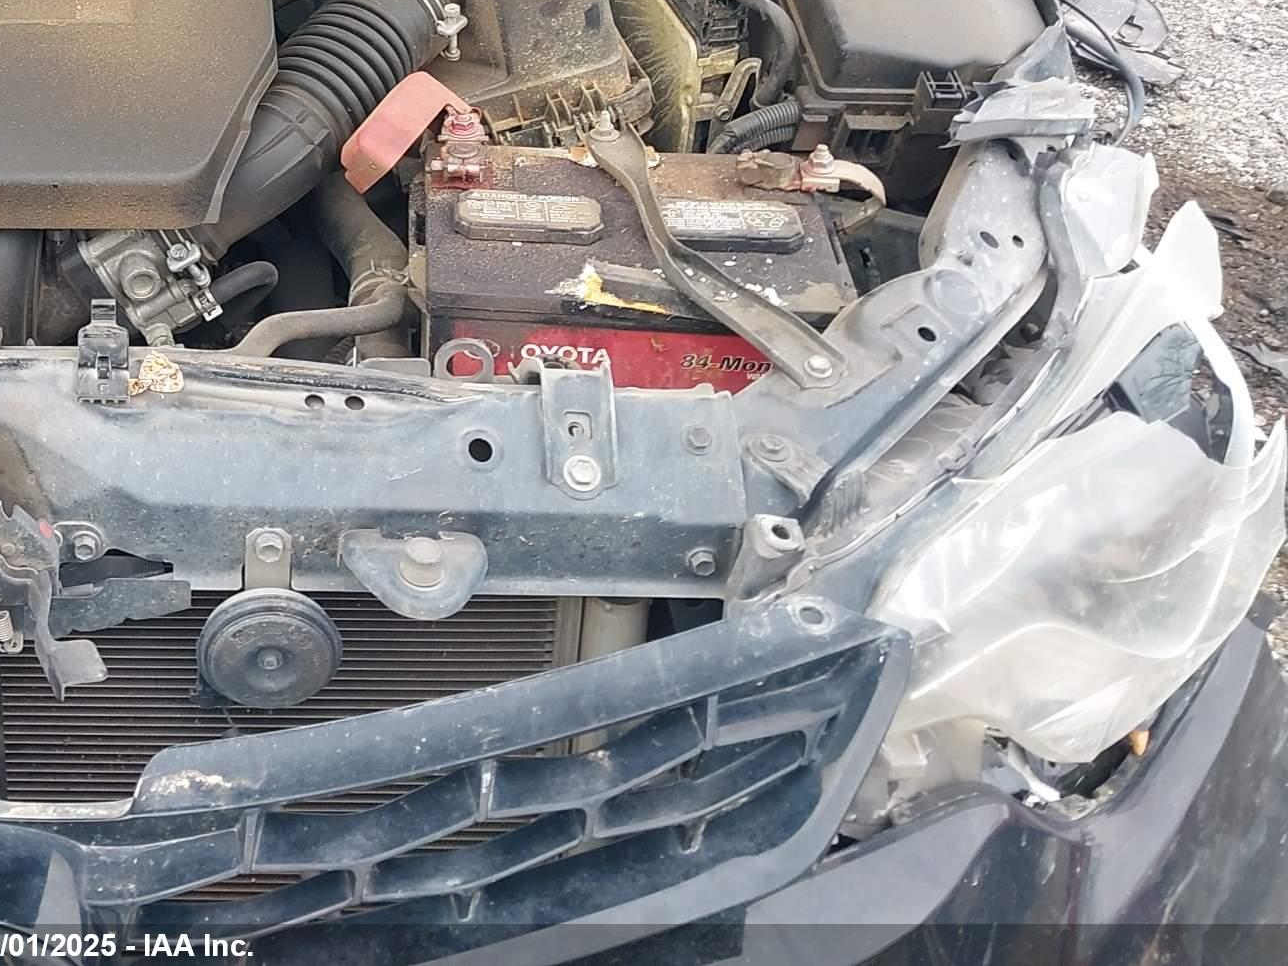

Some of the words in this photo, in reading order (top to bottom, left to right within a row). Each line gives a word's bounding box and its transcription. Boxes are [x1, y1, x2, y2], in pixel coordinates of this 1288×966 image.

[482, 193, 527, 201] DANGER
[538, 195, 580, 203] POISON
[509, 344, 611, 365] OYOTA
[680, 353, 774, 374] 84-Mon
